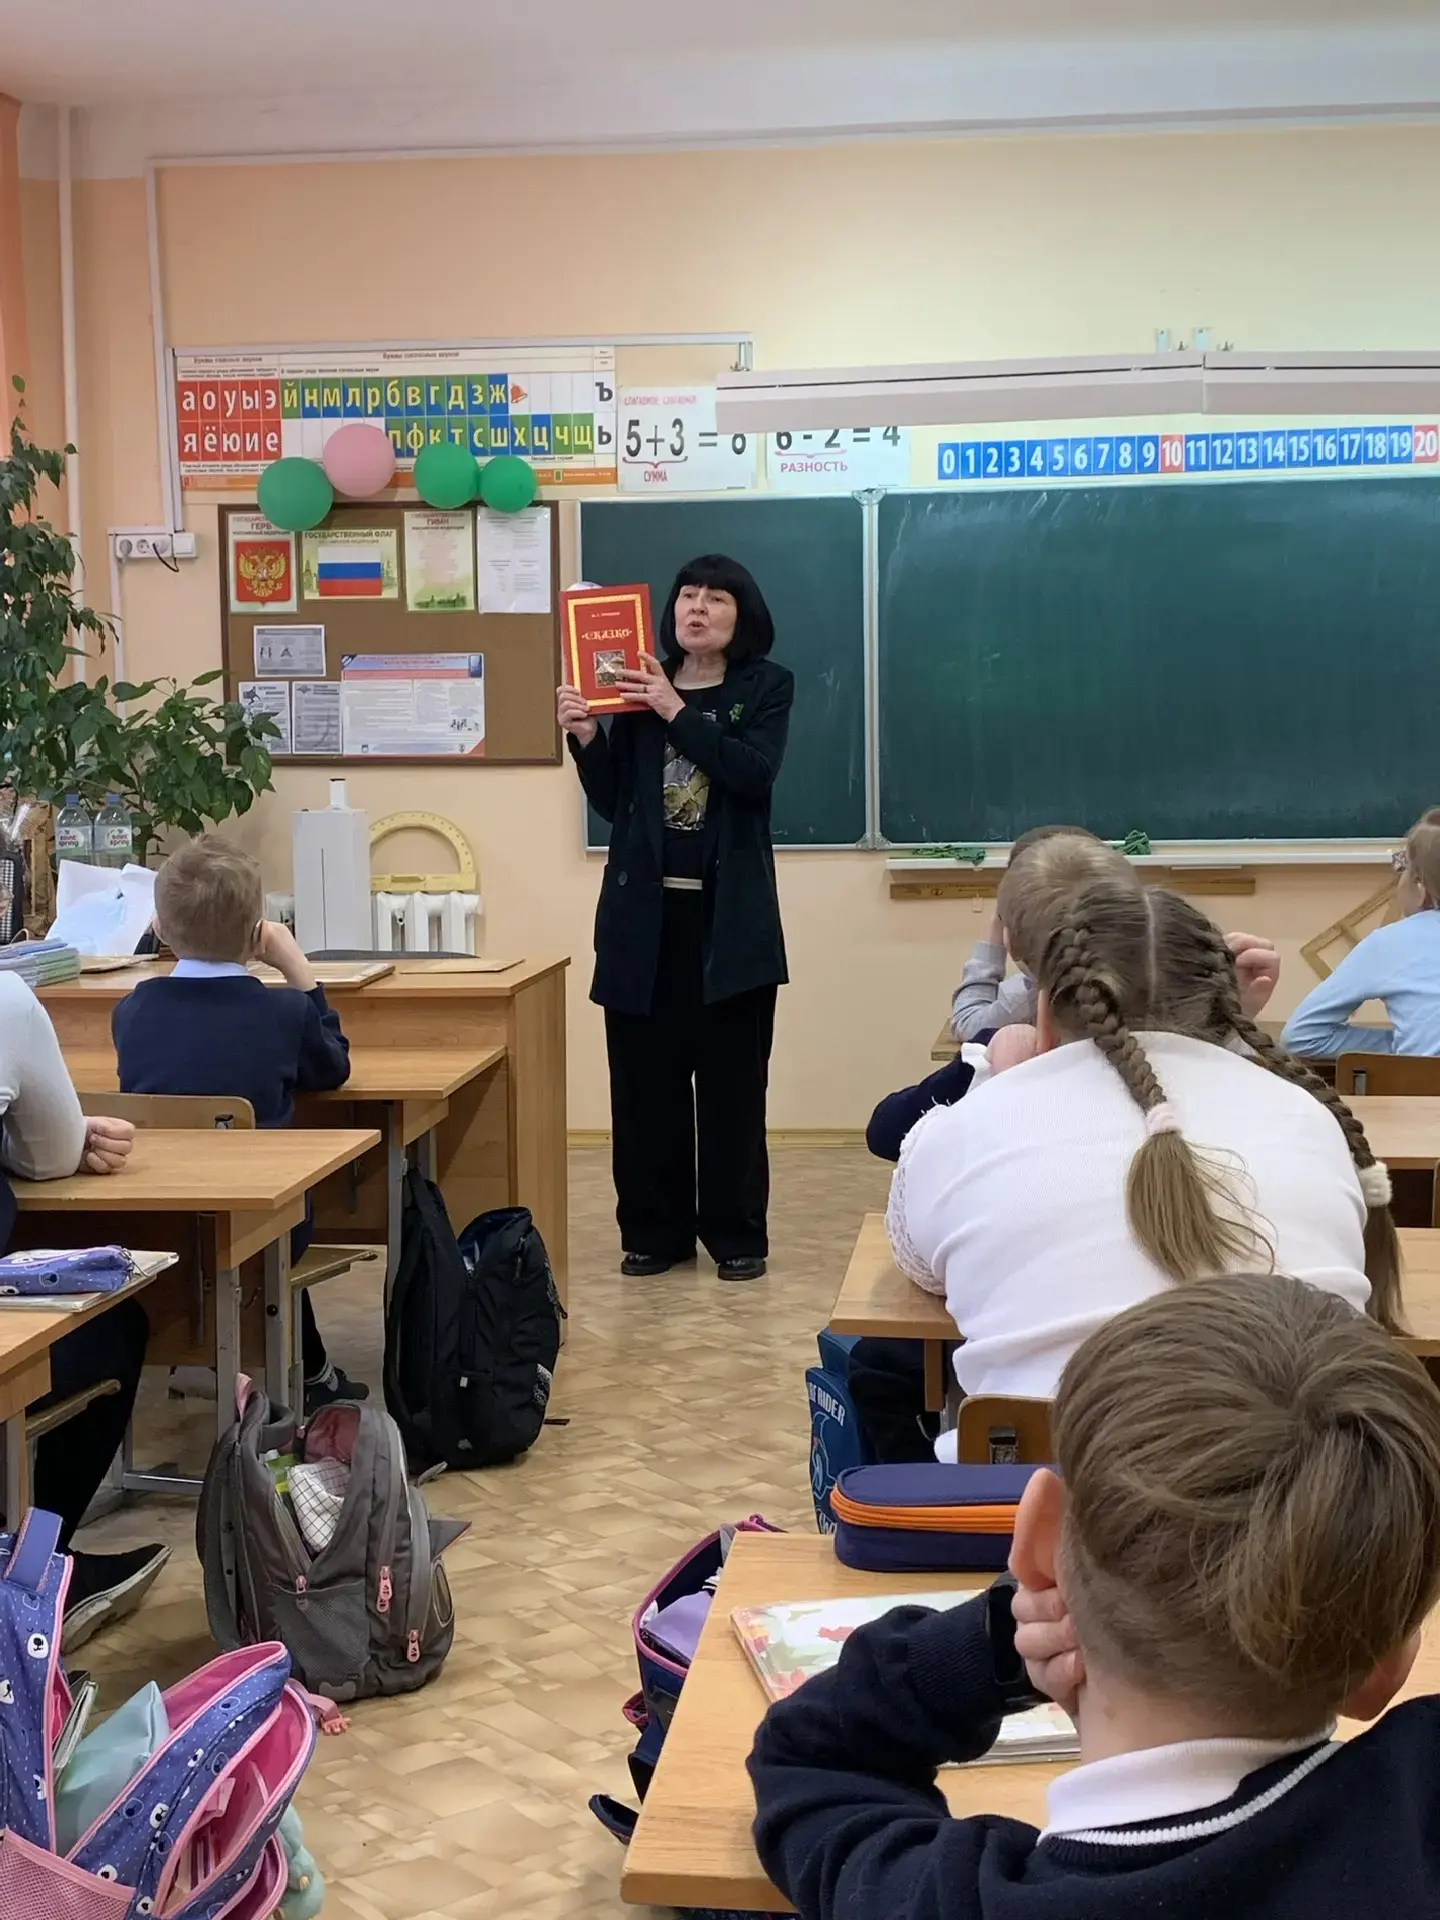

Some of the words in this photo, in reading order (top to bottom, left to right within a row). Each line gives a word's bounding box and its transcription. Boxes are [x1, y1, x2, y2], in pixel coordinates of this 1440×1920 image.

[942, 449, 956, 474] 0
[965, 448, 975, 474] 1
[986, 447, 998, 473] 2
[1008, 446, 1020, 472] 3
[1030, 446, 1044, 472] 4
[1052, 444, 1064, 471] 5
[1074, 444, 1088, 470] 6
[1097, 444, 1110, 468] 7
[1118, 442, 1132, 468] 8
[1142, 441, 1156, 468] 9
[1162, 440, 1182, 467] 10
[1186, 440, 1206, 466] 11
[1212, 438, 1233, 465] 12
[1237, 438, 1258, 464] 13
[1263, 436, 1285, 462] 14
[1289, 436, 1310, 462] 15
[1313, 434, 1336, 460] 16
[1340, 433, 1361, 460] 17
[1364, 432, 1386, 458] 18
[1390, 432, 1411, 458] 19
[1414, 430, 1438, 457] 20
[780, 462, 848, 472] РАЗНОСТЬ
[644, 471, 668, 482] СУММА
[251, 522, 272, 530] ГЕРБ
[304, 530, 374, 539] ГОСУДАРСТВЕННЫЙ
[374, 530, 393, 538] ФЛАГ
[818, 1386, 846, 1426] RIDER
